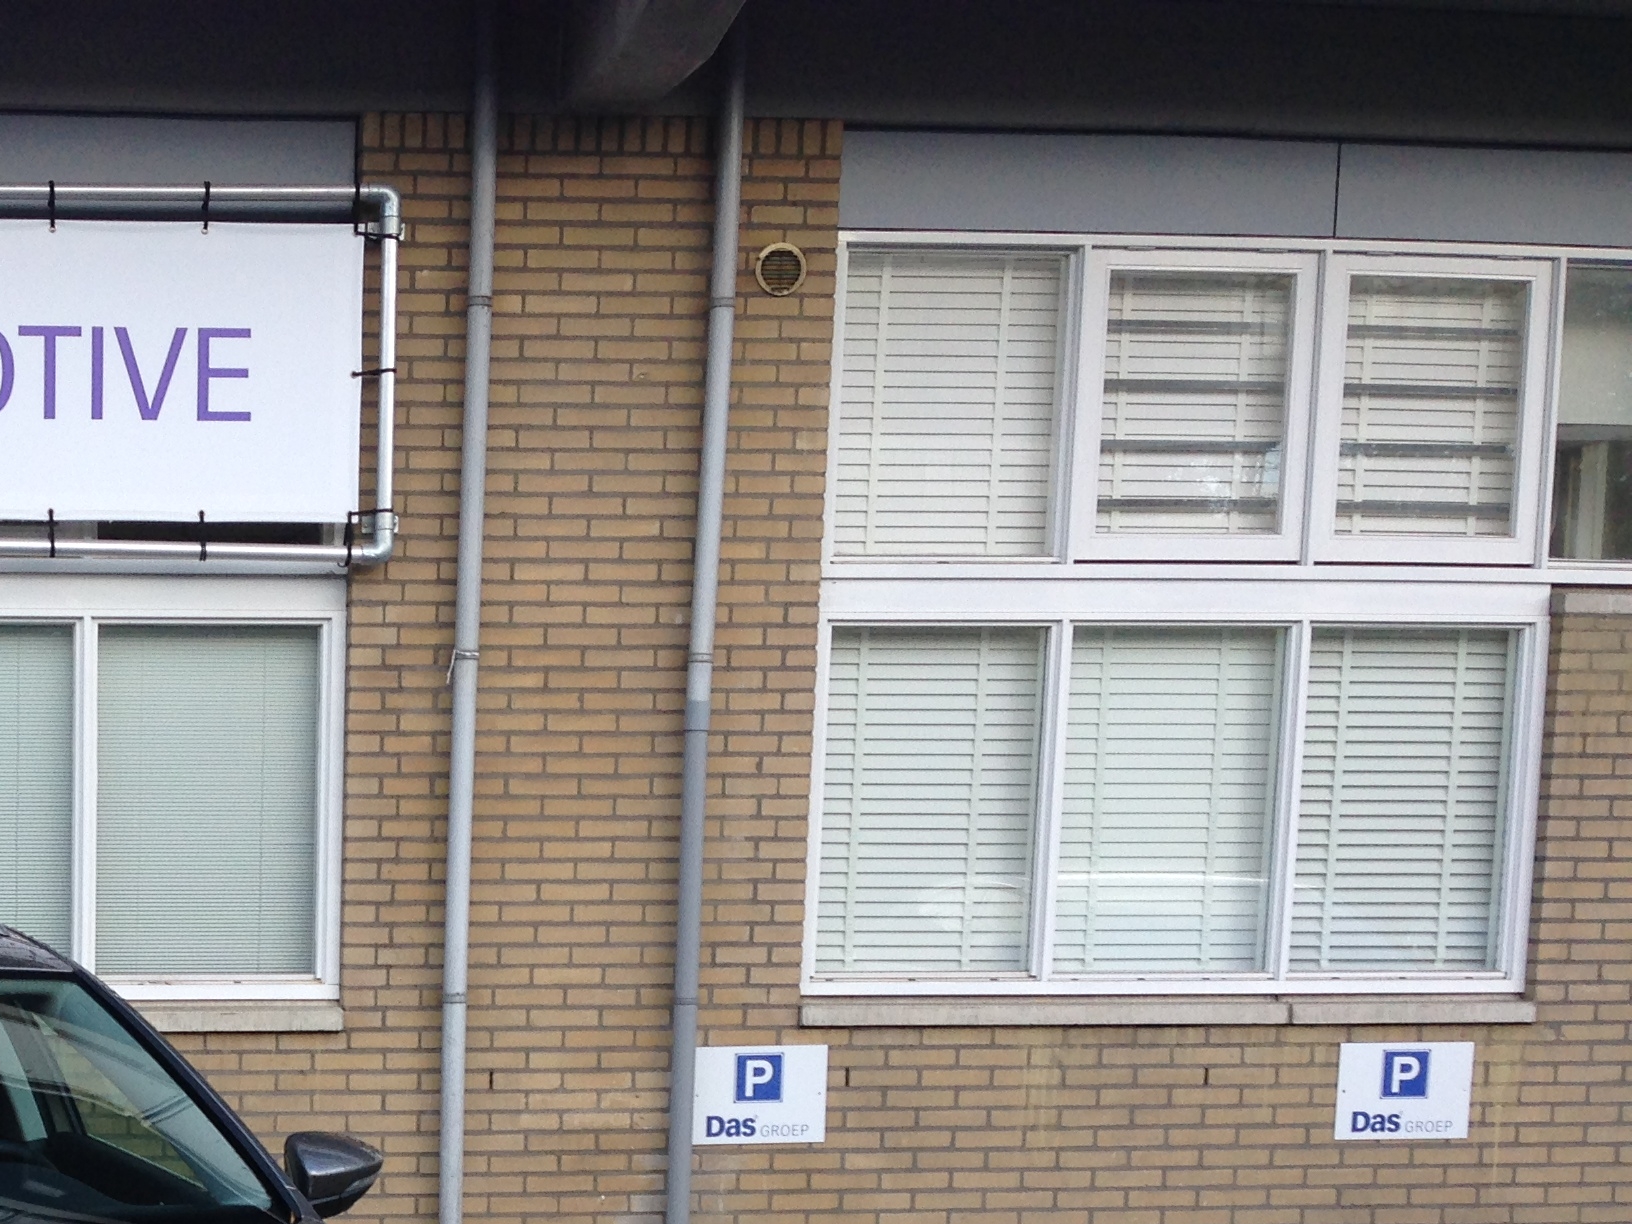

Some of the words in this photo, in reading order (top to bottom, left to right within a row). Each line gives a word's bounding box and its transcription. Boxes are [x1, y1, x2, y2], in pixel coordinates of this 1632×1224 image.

[745, 1060, 774, 1097] P
[1391, 1056, 1421, 1093] P
[760, 1124, 810, 1138] GROEP
[1404, 1120, 1454, 1133] GROEP
